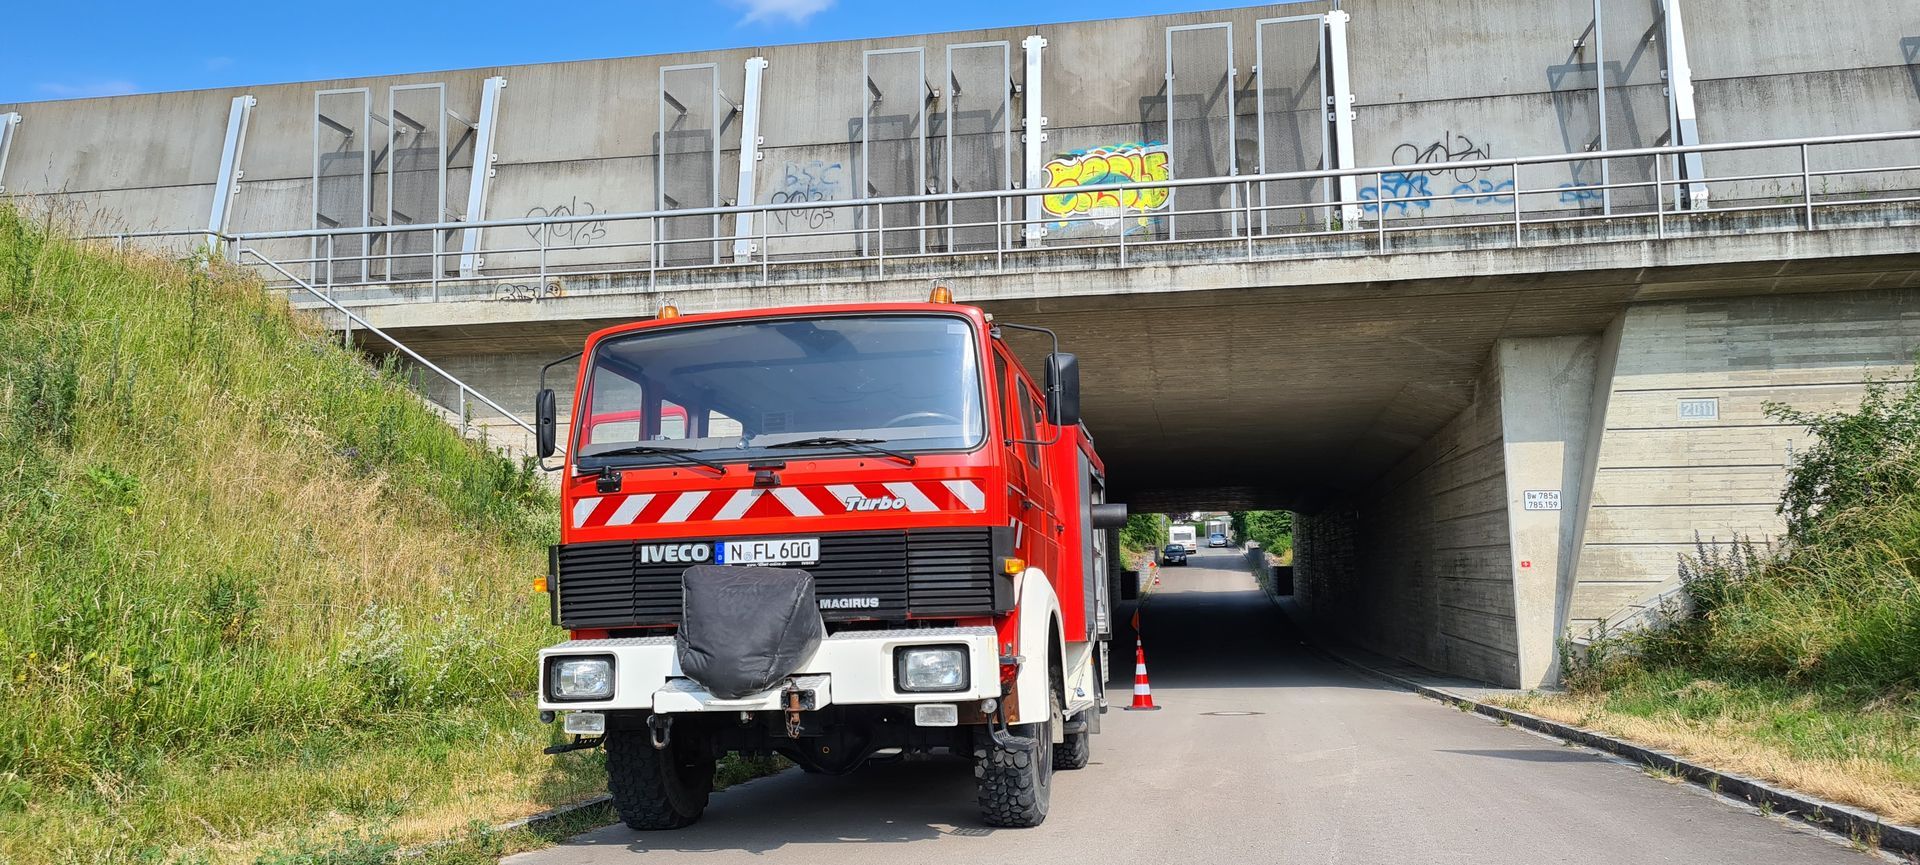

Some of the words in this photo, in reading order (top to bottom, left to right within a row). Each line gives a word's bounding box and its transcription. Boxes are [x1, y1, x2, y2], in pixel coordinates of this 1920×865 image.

[1681, 401, 1714, 416] 2011
[845, 495, 906, 512] Turbo
[1538, 492, 1558, 500] 785a
[1528, 501, 1558, 509] 785.159
[640, 543, 710, 564] IVECO
[731, 543, 742, 561] N
[753, 542, 776, 560] FL
[780, 542, 811, 559] 600
[819, 597, 879, 609] MAGIRUS
